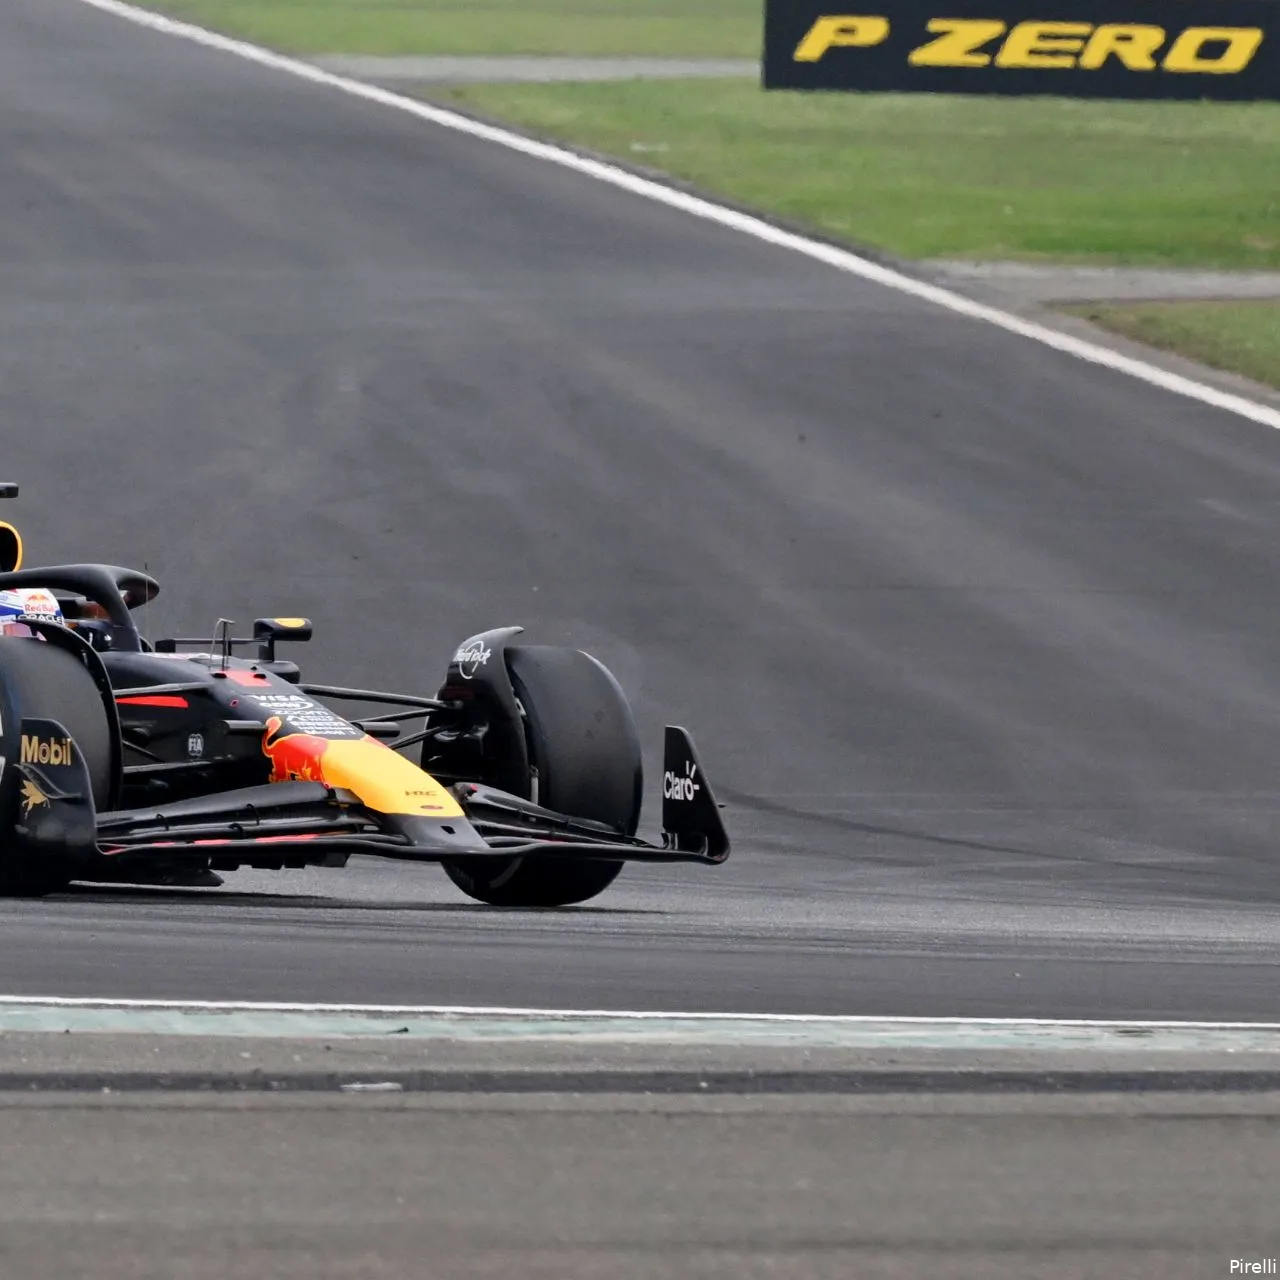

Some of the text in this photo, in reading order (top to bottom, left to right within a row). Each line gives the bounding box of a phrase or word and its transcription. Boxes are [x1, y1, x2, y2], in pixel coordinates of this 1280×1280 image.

[793, 15, 1263, 73] P ZERO
[21, 734, 72, 766] Mobil
[188, 739, 203, 752] FIA
[663, 770, 696, 801] Claro
